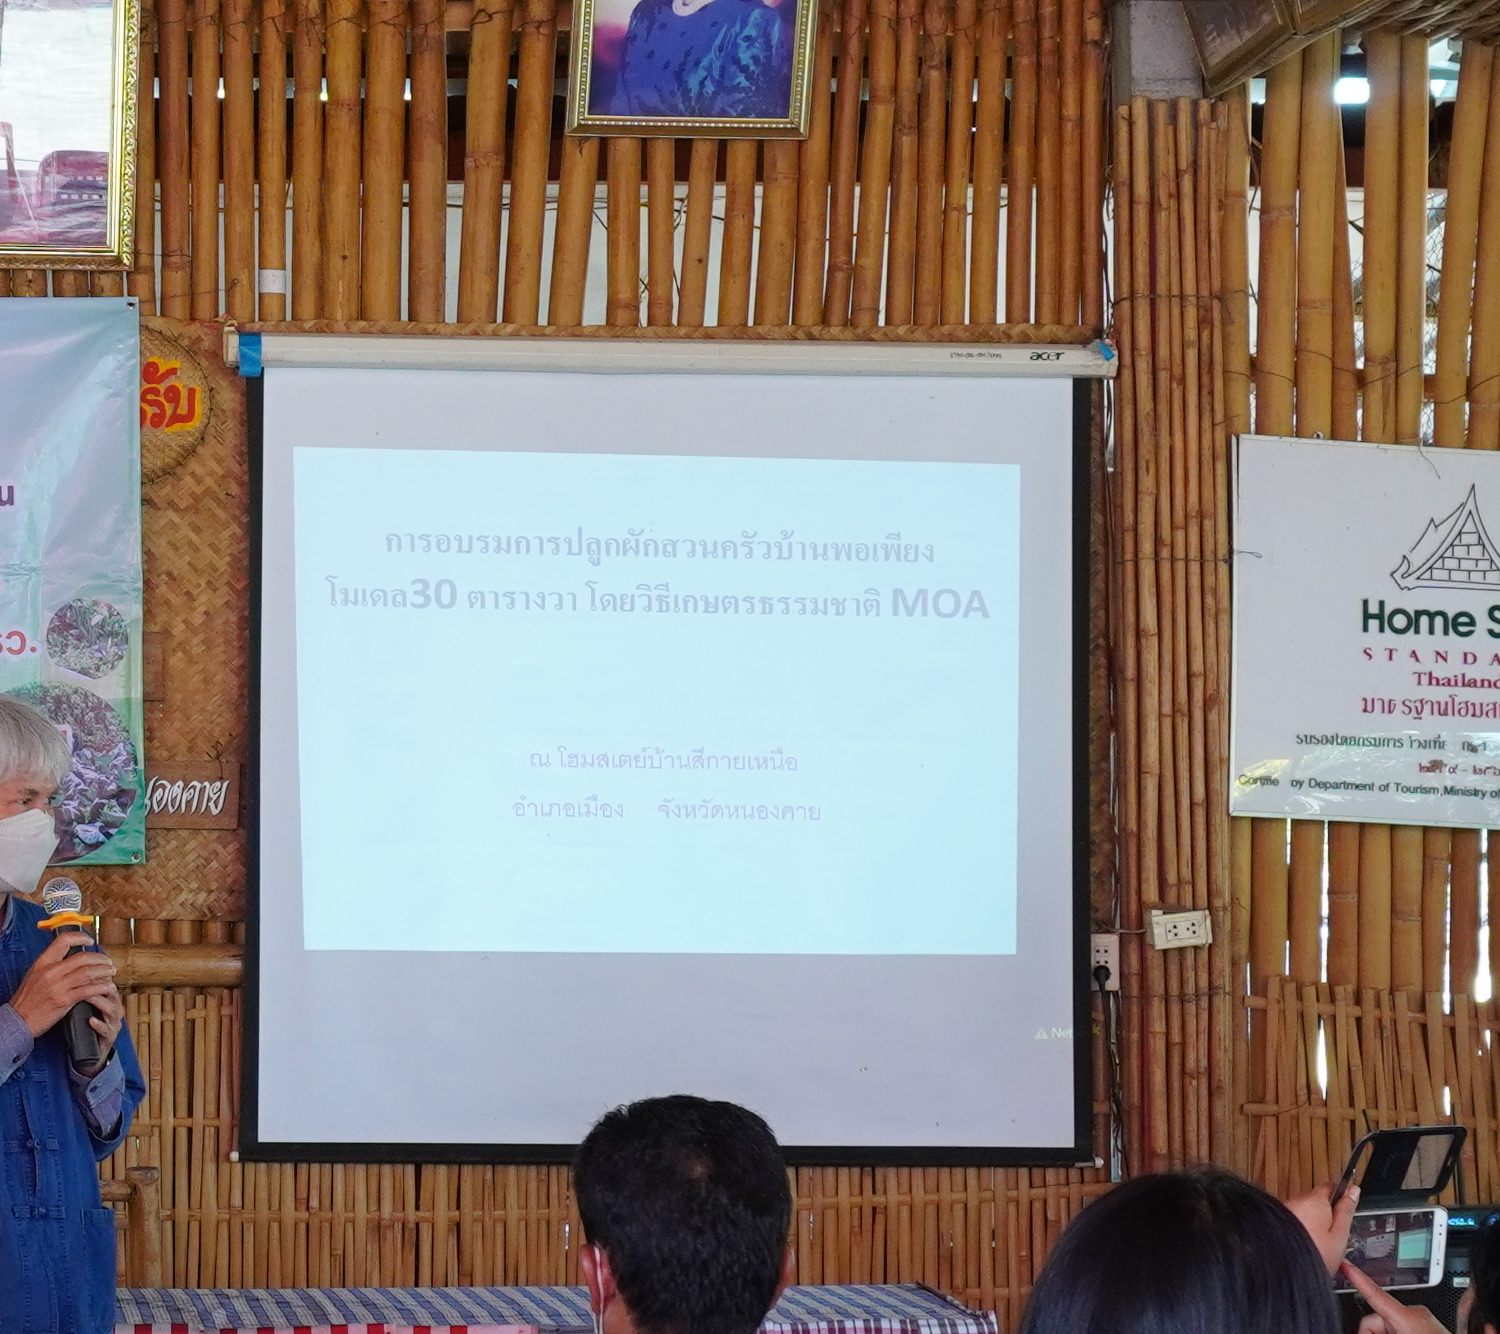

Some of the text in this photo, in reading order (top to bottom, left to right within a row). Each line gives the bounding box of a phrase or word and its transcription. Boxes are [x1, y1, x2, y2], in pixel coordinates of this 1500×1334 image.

[1030, 351, 1066, 362] acer
[385, 525, 935, 567] การอบรมการปลูกผักสวนครัวบ้านพอเพียง
[467, 588, 579, 613] ตารางวา
[586, 580, 882, 619] โดยวิธีเกษตรธรรมชาติ
[891, 587, 991, 620] MOA
[1361, 599, 1478, 639] Home
[530, 744, 799, 772] ณ โฮมสเตย์บ้านสีกายเหนือ
[1309, 777, 1375, 794] Department
[1379, 782, 1391, 793] of
[1491, 788, 1500, 799] of
[512, 793, 822, 824] อำเภอเมือง จังหวัดหนองคาย
